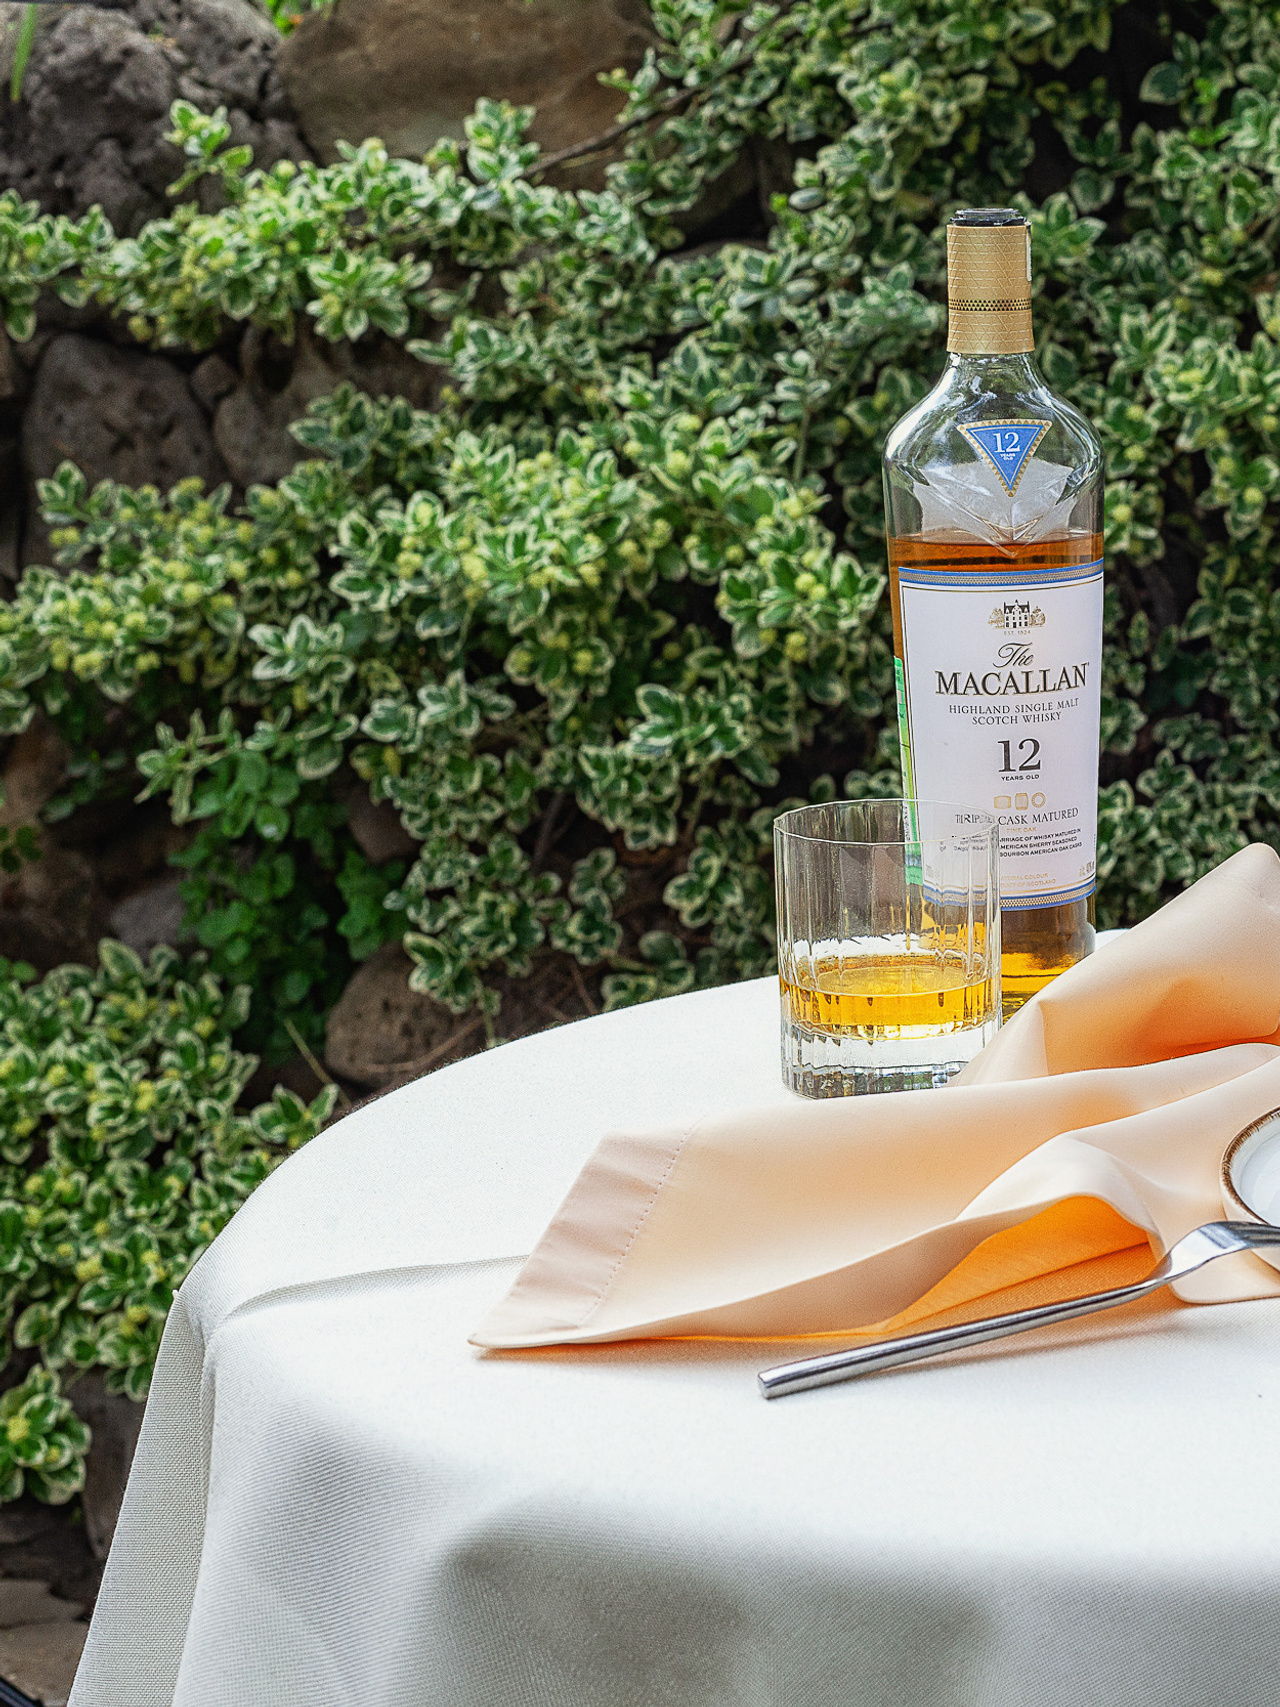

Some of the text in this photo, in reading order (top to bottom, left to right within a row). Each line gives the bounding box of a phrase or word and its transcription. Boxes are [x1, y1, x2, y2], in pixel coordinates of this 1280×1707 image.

[993, 432, 1020, 453] 12
[992, 642, 1035, 668] The
[935, 663, 1088, 696] MACALLAN
[949, 698, 1079, 715] HIGHLAND SINGLE MALT
[972, 712, 1062, 726] SCOTCH WHISKY
[997, 738, 1041, 773] 12
[998, 815, 1027, 826] CASK
[1032, 807, 1079, 824] MATURED
[1052, 836, 1077, 845] SEASONED
[1055, 829, 1076, 837] MATURED
[1030, 847, 1058, 856] AMERICAN
[1026, 878, 1056, 886] SCOTLAND
